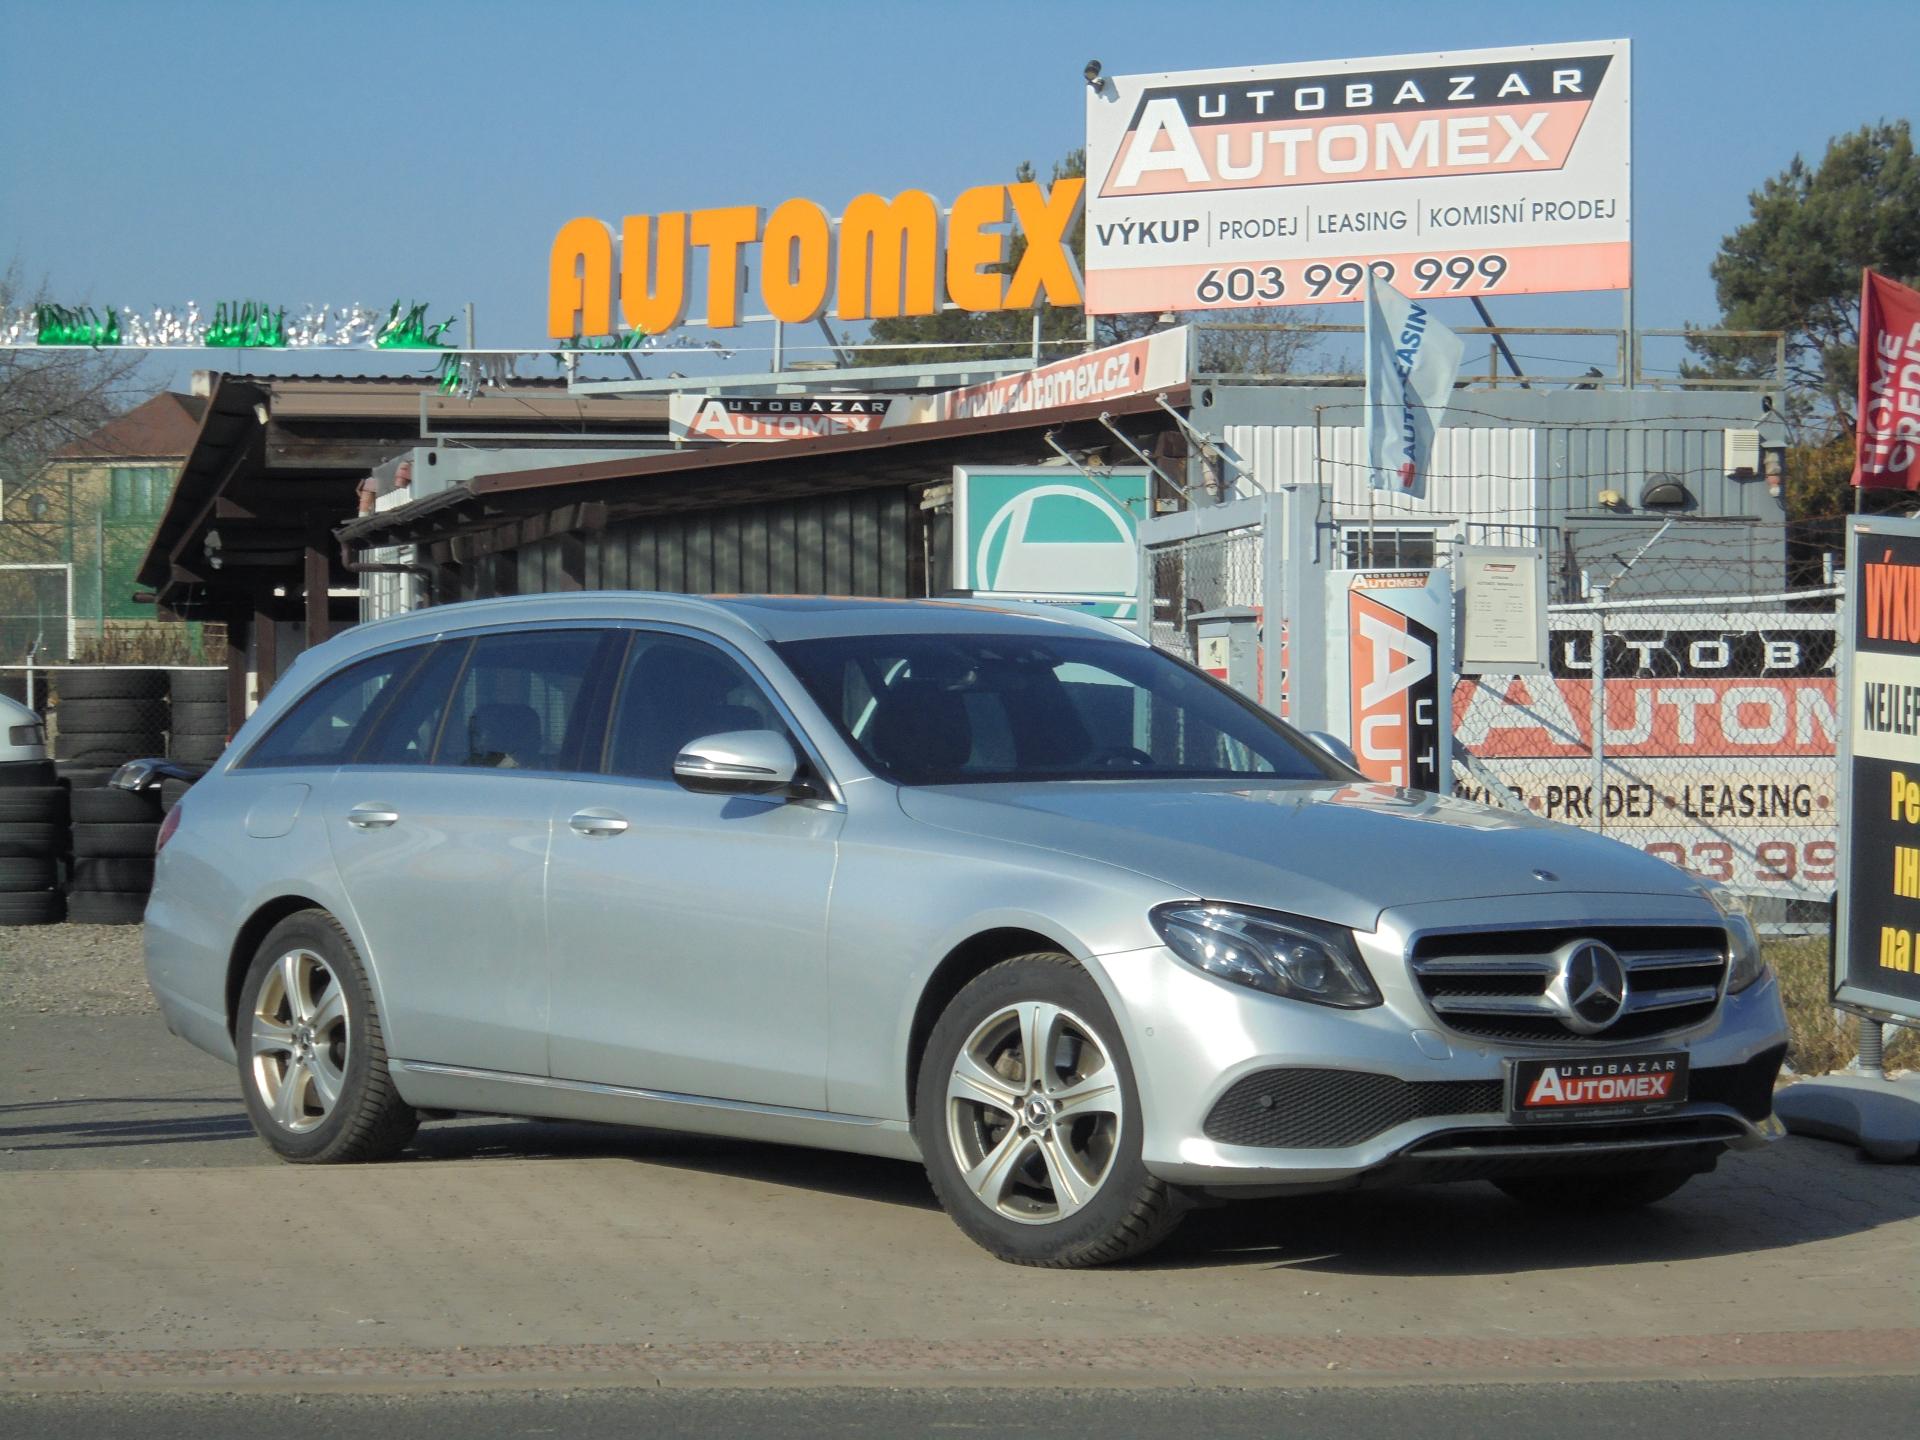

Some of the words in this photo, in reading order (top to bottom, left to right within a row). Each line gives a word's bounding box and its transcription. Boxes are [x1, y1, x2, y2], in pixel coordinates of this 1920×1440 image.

[1113, 98, 1550, 188] AUTOMEX
[1096, 217, 1200, 246] VÝKUP
[1218, 216, 1299, 240] PRODEJ
[1316, 210, 1408, 235] LEASING
[1429, 197, 1526, 229] KOMISNÍ
[1531, 198, 1617, 223] PRODEJ
[548, 177, 1087, 340] AUTOMEX
[1197, 266, 1285, 303] 603
[1304, 259, 1395, 297] 999
[1414, 254, 1509, 294] 999
[693, 400, 872, 437] AUTOMEX
[1862, 328, 1903, 475] HOME
[1350, 573, 1425, 589] AUTOMEX
[1684, 784, 1811, 818] LEASING
[1879, 926, 1912, 972] na
[1530, 1067, 1666, 1103] AUTOMEX
